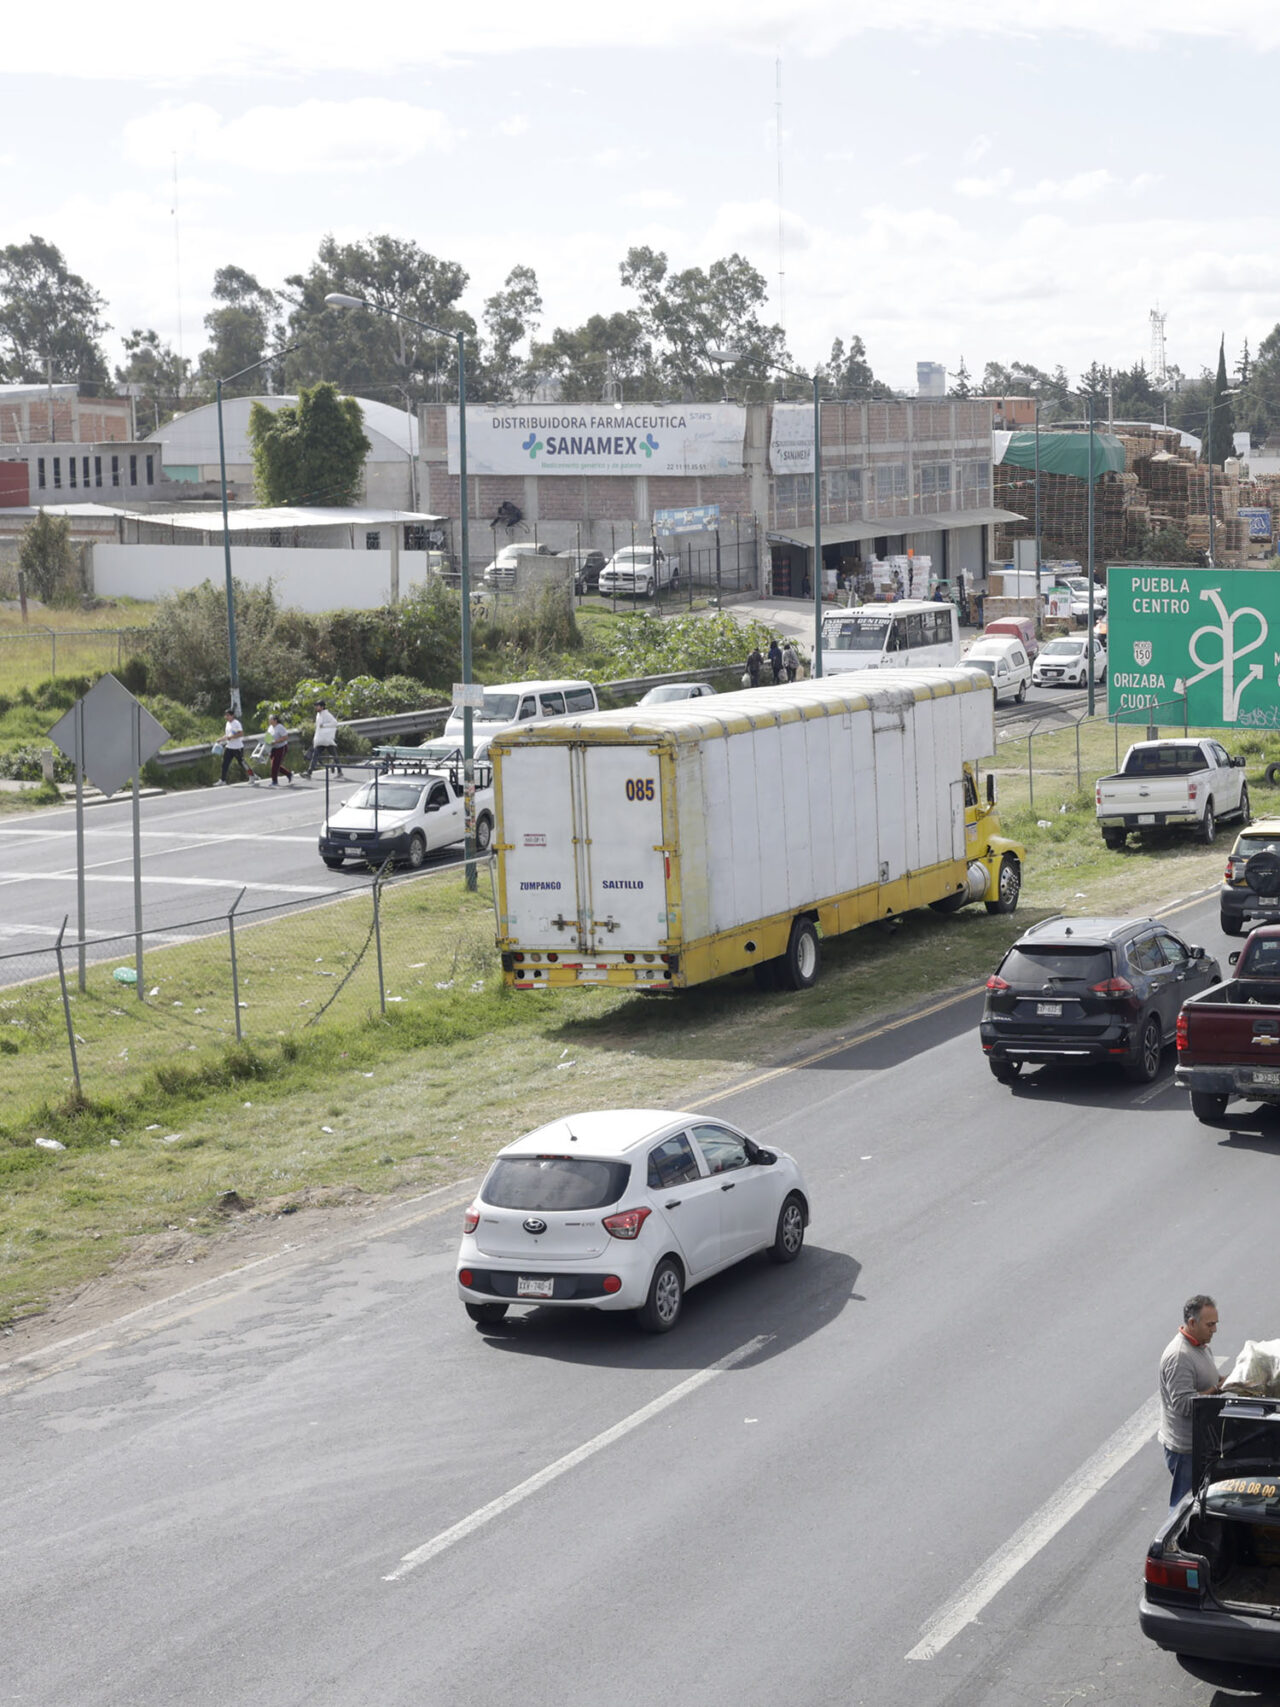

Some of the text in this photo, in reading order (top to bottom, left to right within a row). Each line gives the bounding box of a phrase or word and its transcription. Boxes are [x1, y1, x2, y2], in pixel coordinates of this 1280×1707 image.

[492, 416, 587, 430] DISTRIBUIDORA
[590, 416, 687, 429] FARMACEUTICA
[546, 437, 637, 455] SANAMEX
[1131, 577, 1190, 593] PUEBLA
[1132, 598, 1190, 615] CENTRO
[1135, 650, 1151, 660] 150
[1113, 673, 1166, 689] ORIZABA
[1120, 693, 1160, 710] CUOTA
[625, 779, 655, 801] 085
[520, 881, 561, 891] ZUMPANGO
[602, 880, 644, 889] SALTILLO
[1247, 1482, 1261, 1495] 08
[1262, 1484, 1276, 1498] 00
